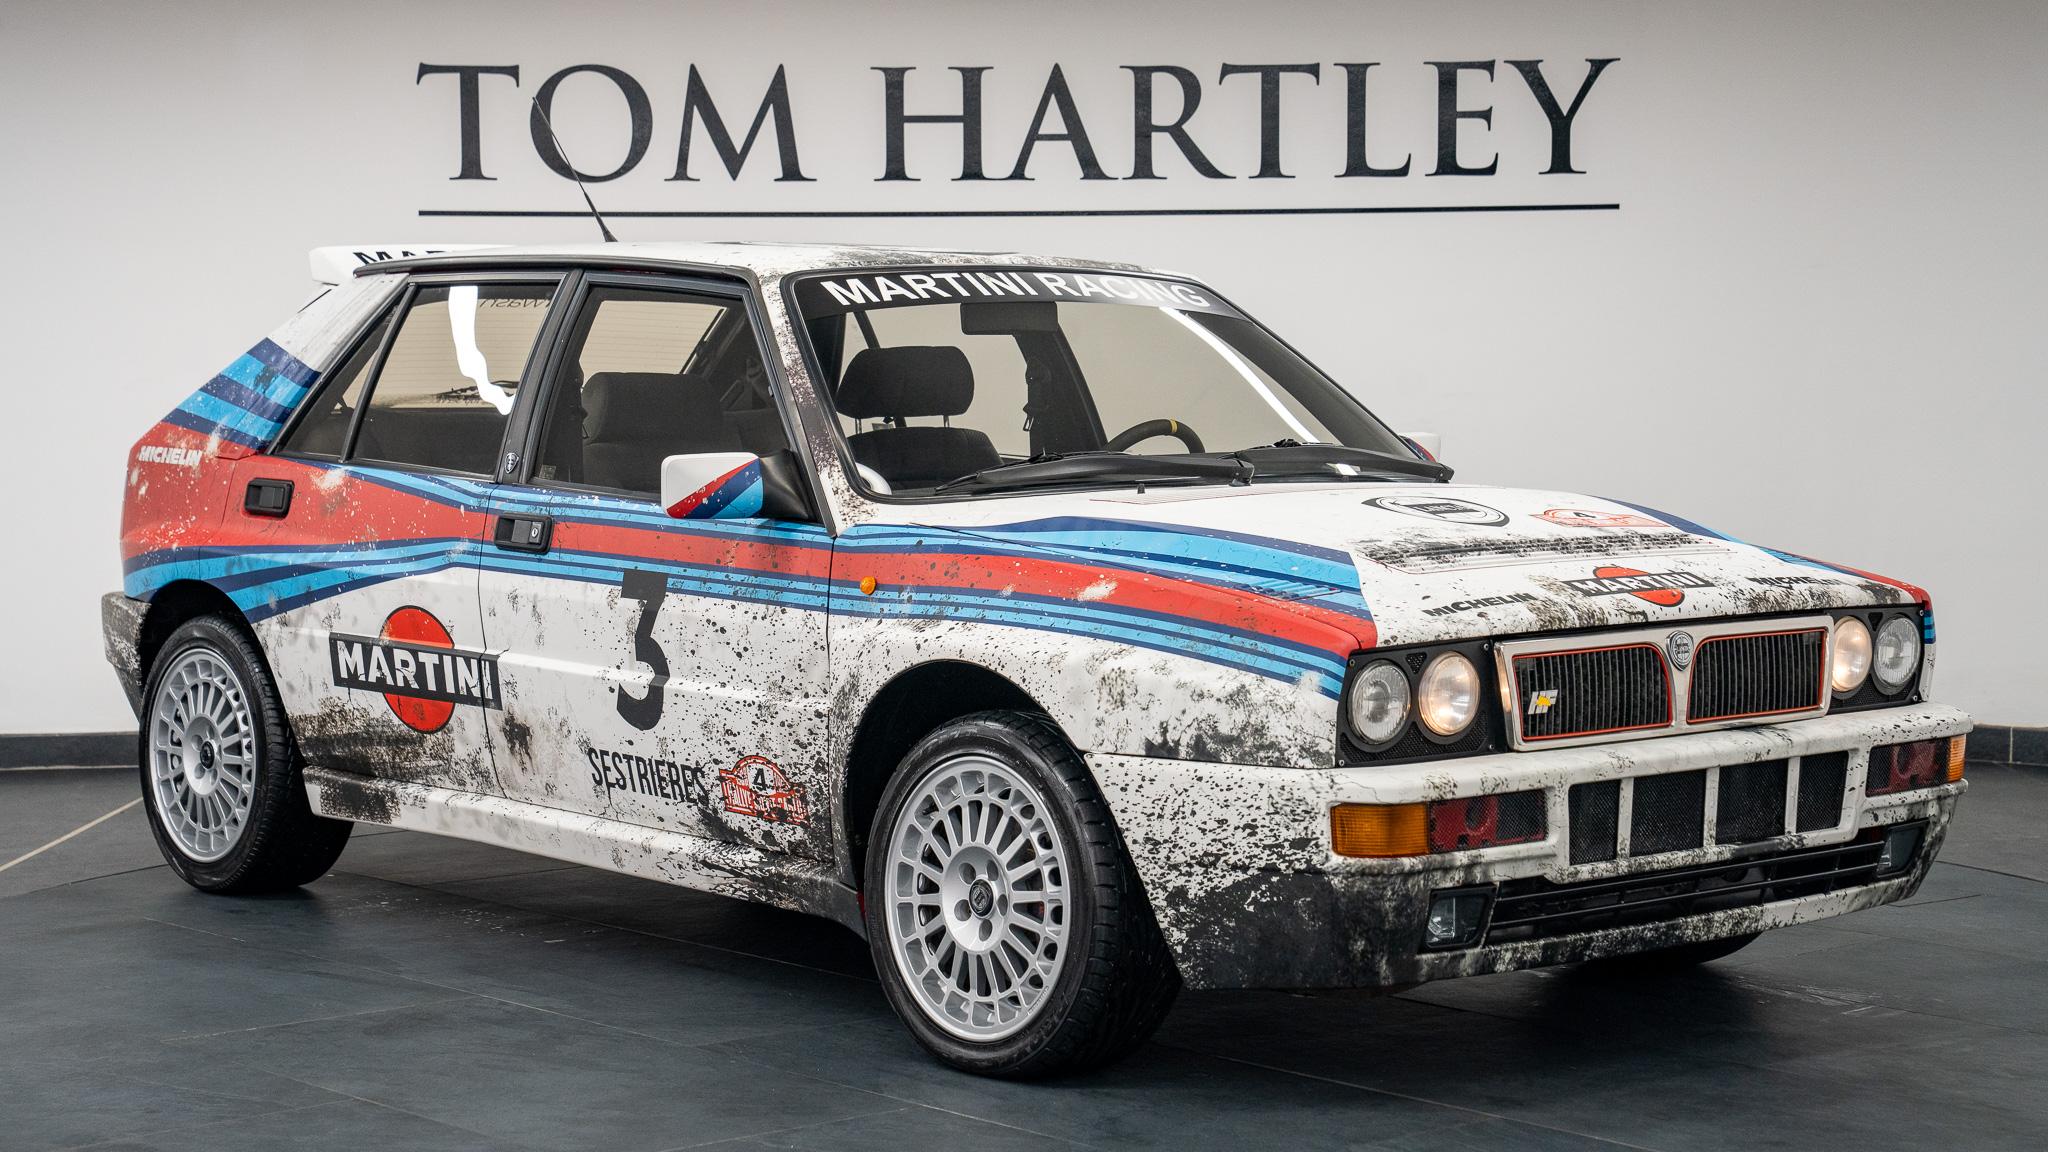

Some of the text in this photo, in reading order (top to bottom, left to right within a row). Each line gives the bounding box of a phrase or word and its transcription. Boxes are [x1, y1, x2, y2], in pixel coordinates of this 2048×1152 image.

[416, 57, 1621, 184] TOM HARTLEY
[820, 271, 1211, 308] MARTINI RACING
[138, 445, 203, 466] MICHELIN
[1571, 572, 1706, 594] MARTINI
[1422, 593, 1540, 617] MICHELIN
[616, 568, 671, 731] 3
[336, 640, 494, 700] MARTINI
[587, 747, 709, 806] SESTRIERES
[753, 767, 767, 791] 4
